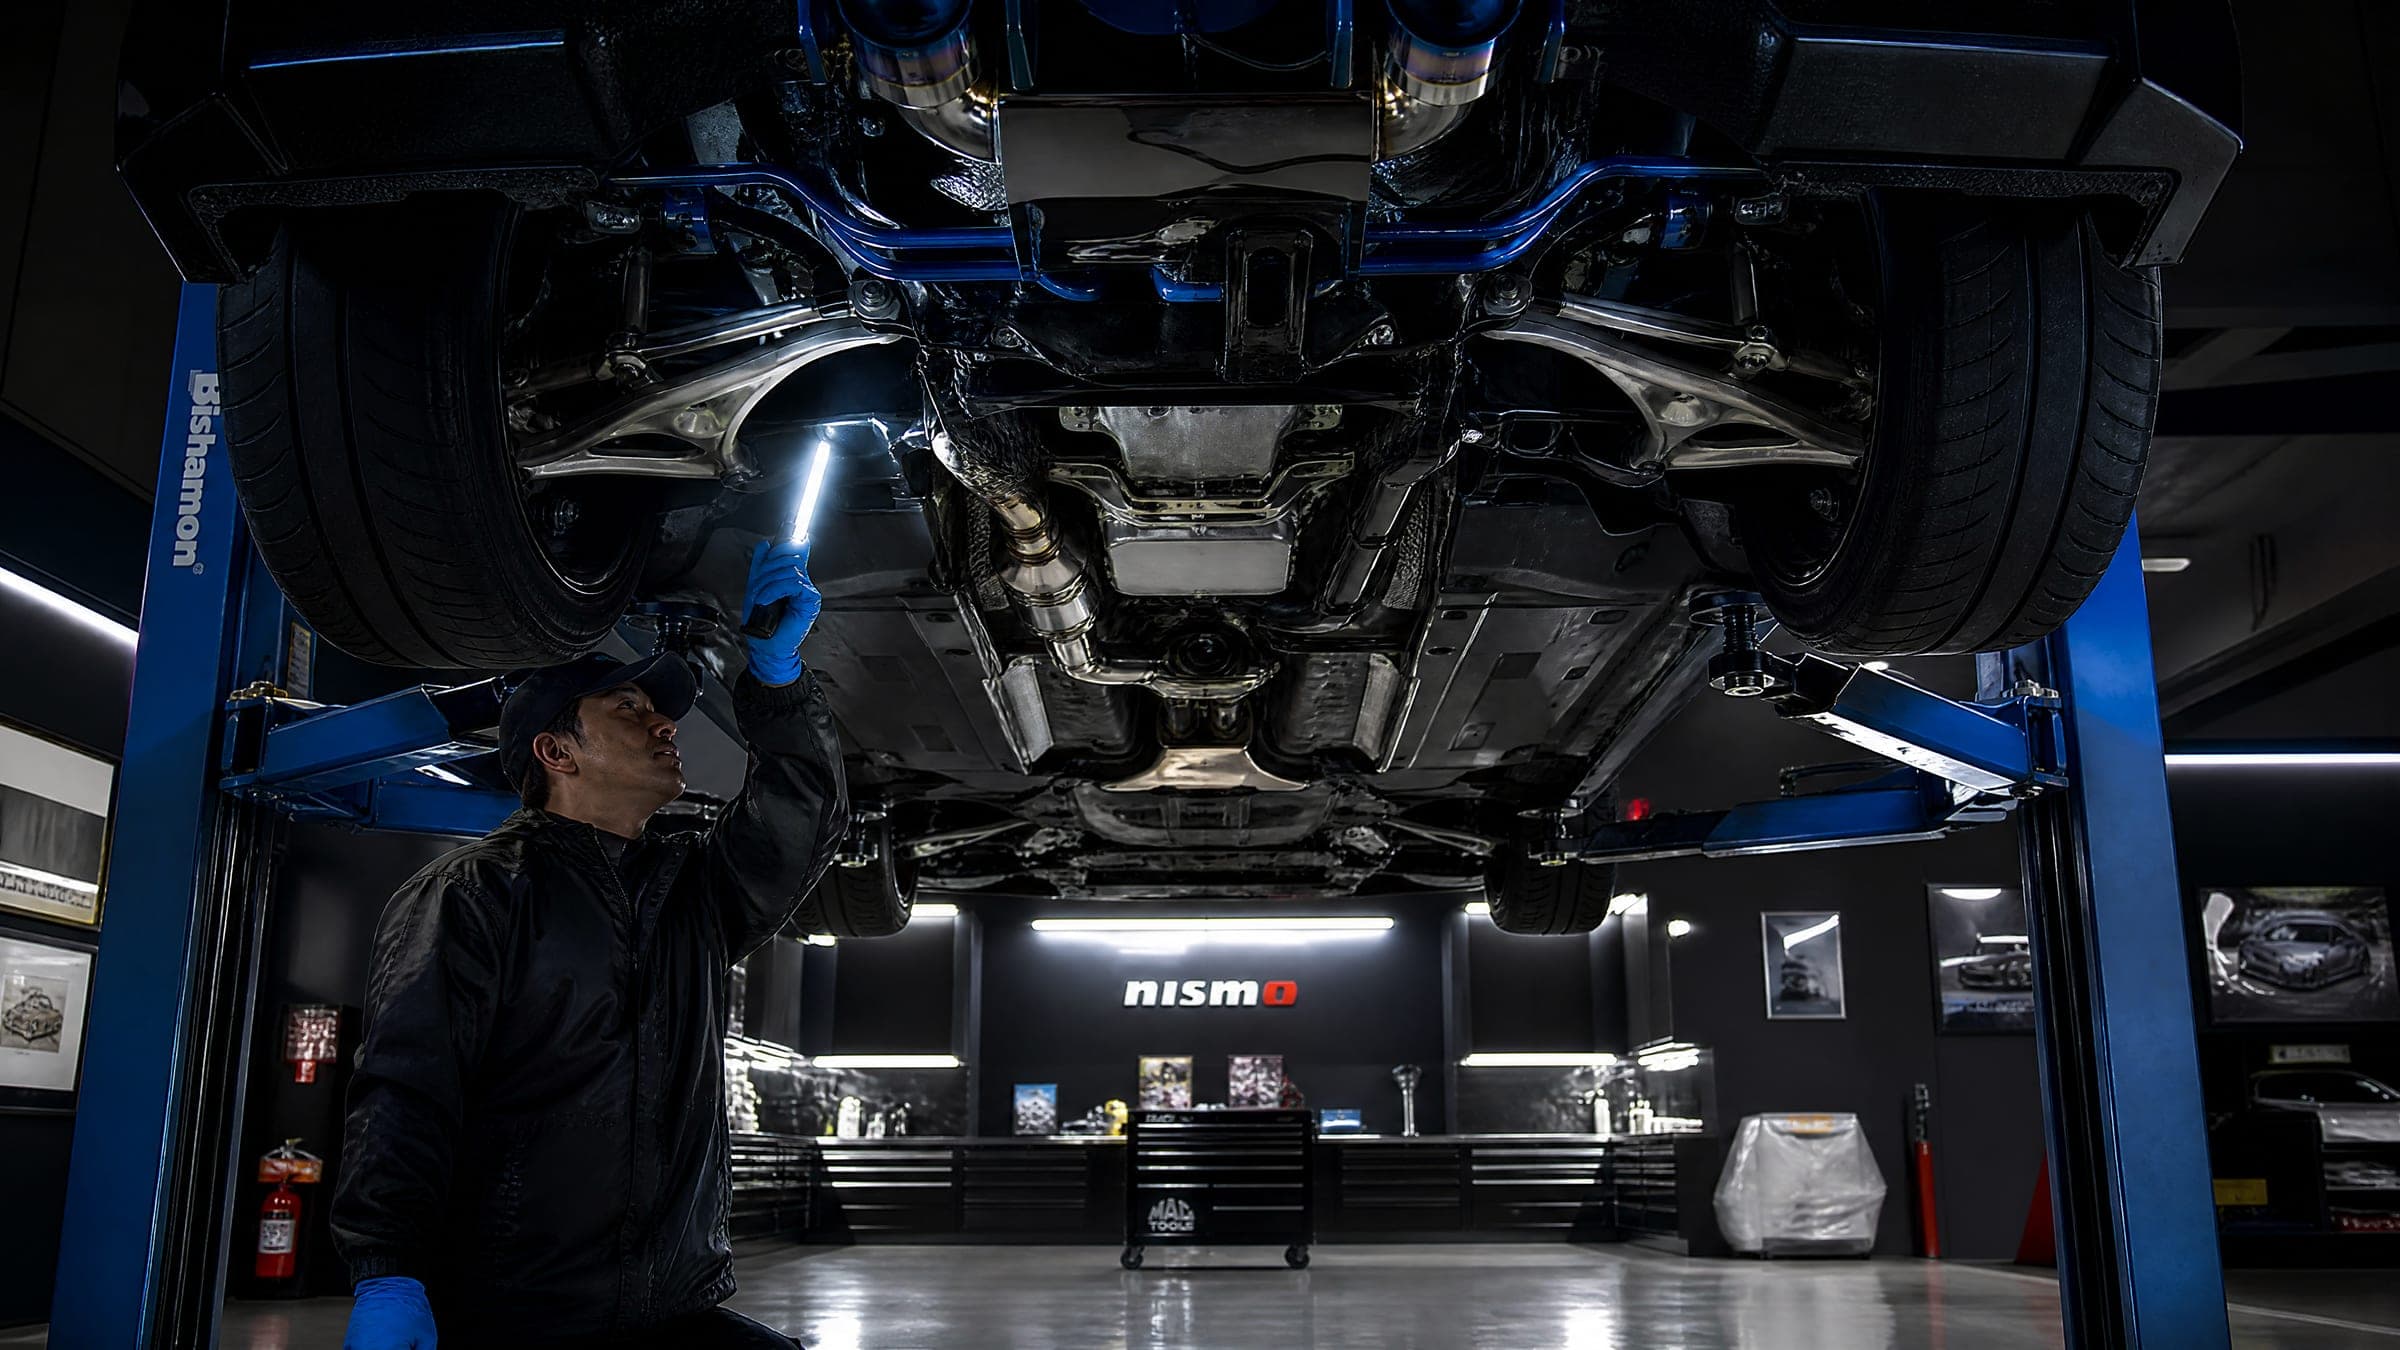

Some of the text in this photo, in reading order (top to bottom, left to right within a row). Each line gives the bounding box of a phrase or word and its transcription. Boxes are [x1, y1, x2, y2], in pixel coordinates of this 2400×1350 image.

[1123, 980, 1298, 1006] nismo
[1148, 1198, 1195, 1221] MAC
[1148, 1220, 1194, 1232] TOOLS
